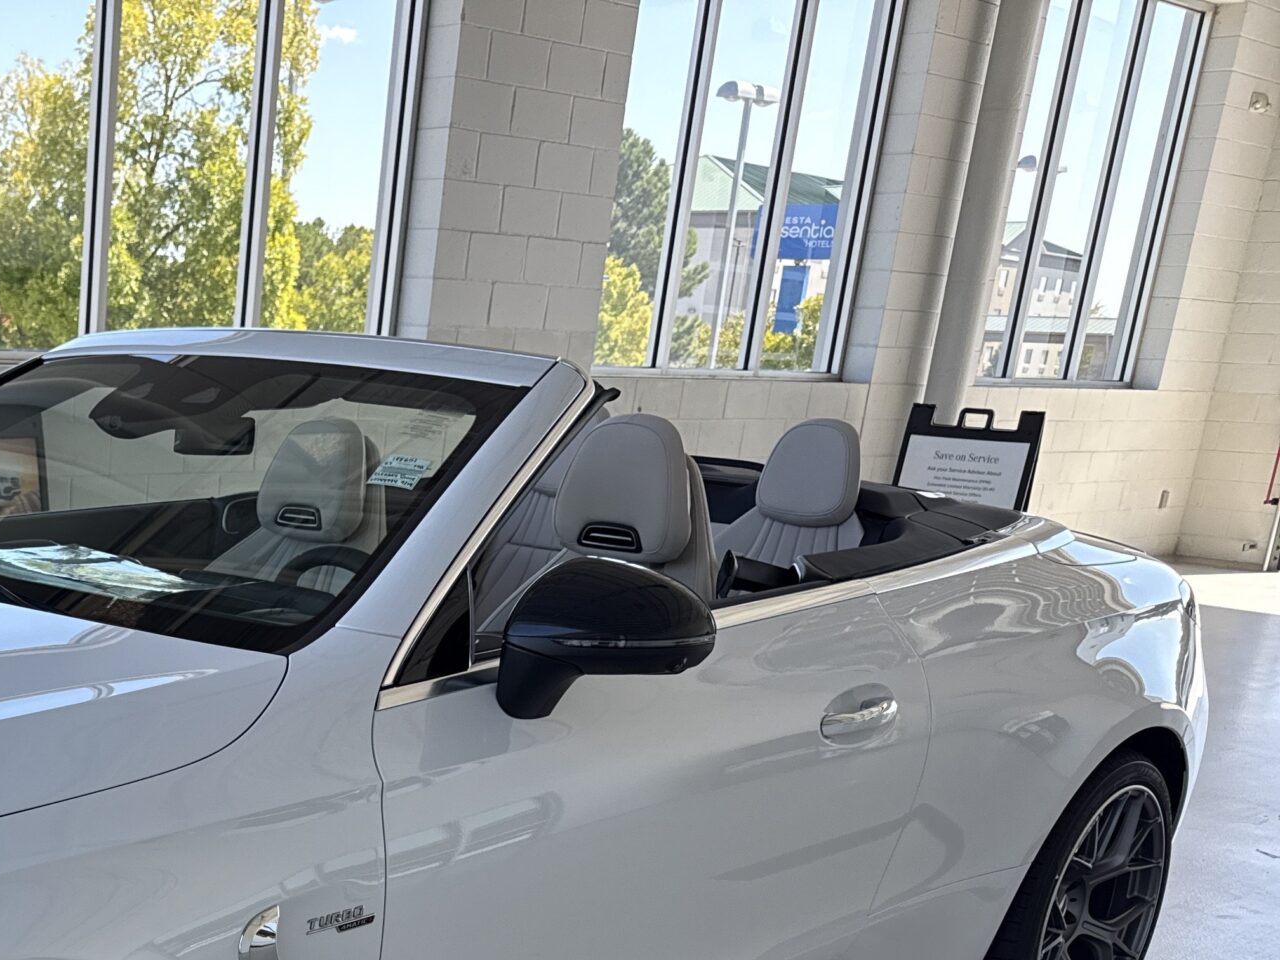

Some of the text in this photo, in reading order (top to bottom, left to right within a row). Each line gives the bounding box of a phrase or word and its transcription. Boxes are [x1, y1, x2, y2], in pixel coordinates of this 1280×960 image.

[785, 216, 811, 224] ESTA
[780, 219, 834, 238] sentia
[933, 450, 1000, 464] Save on Service
[307, 905, 363, 930] TURBO
